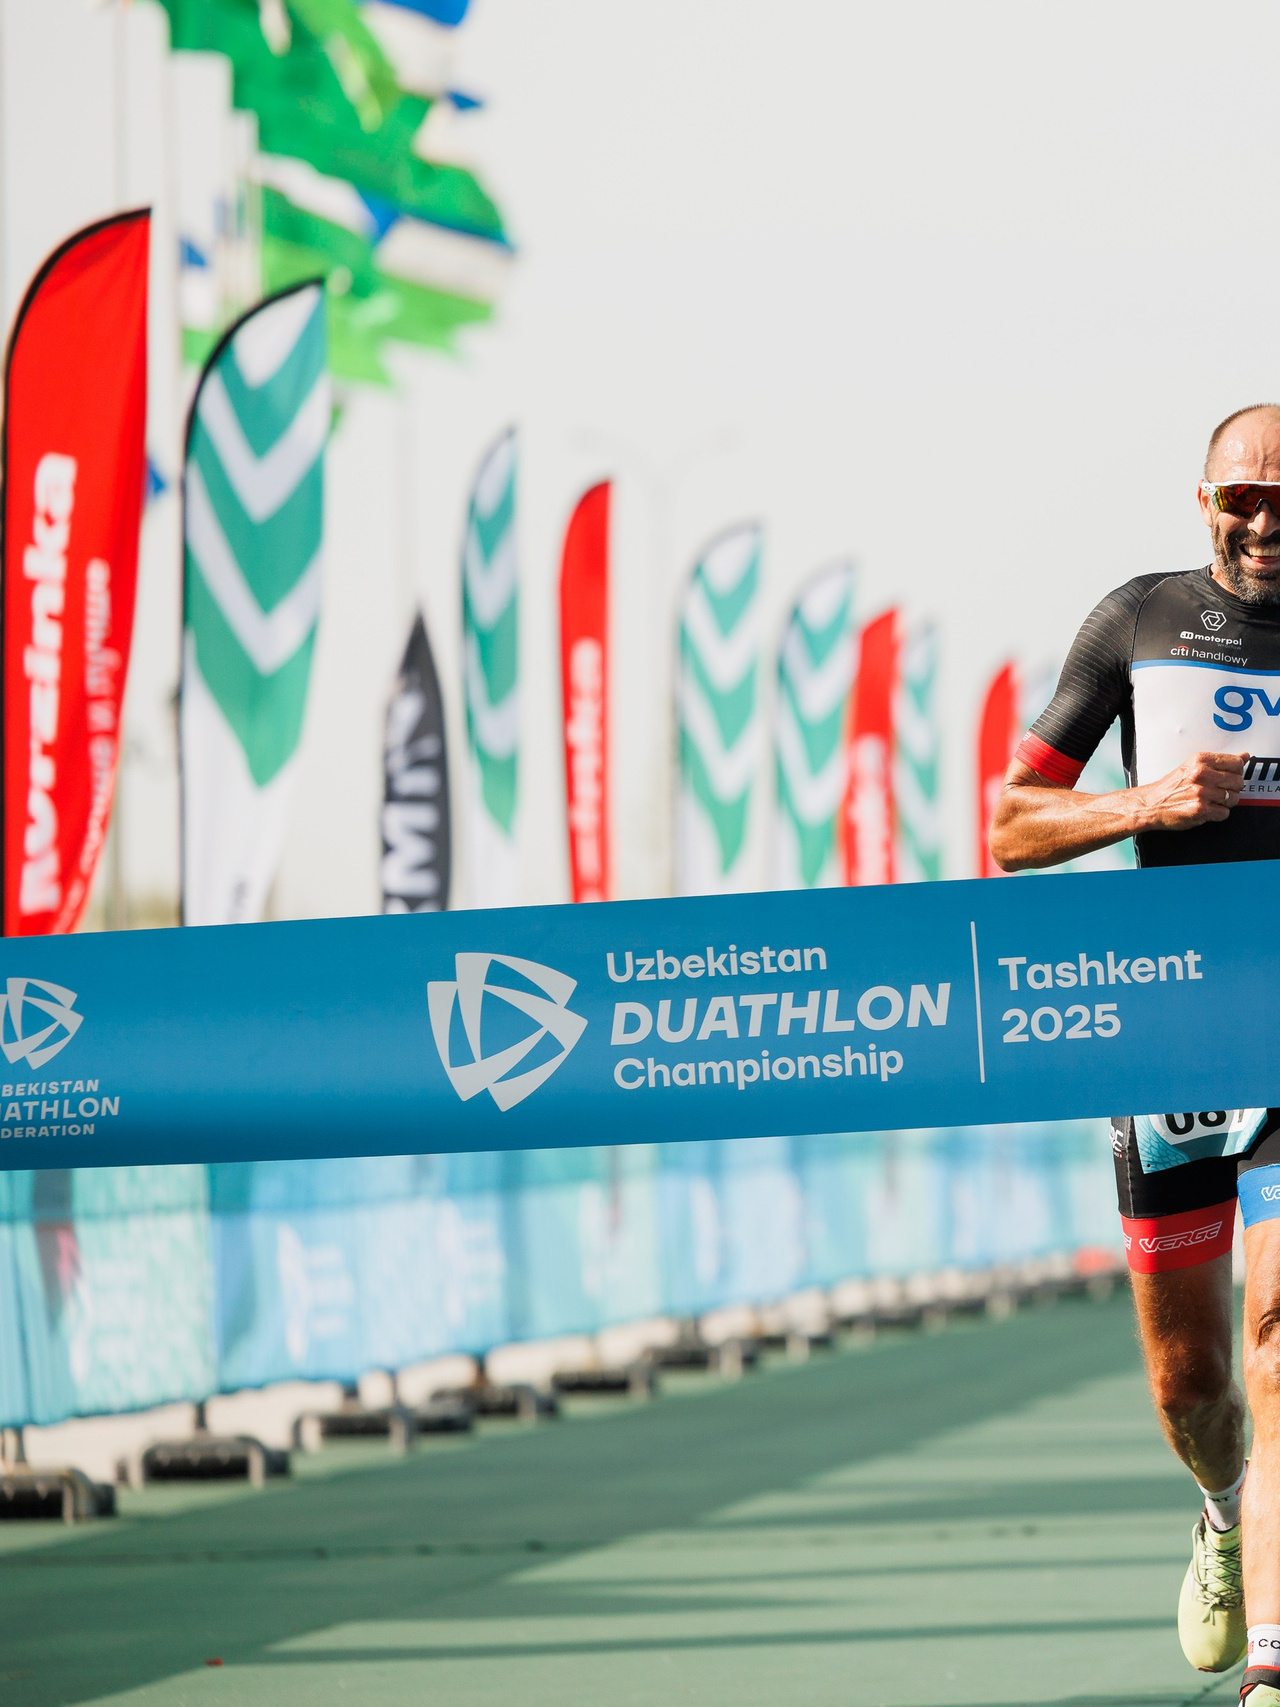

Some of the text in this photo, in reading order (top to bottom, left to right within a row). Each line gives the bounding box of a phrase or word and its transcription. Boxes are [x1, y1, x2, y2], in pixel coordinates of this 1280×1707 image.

[1170, 645, 1248, 666] citi handlowy
[1194, 634, 1242, 646] motorpol
[606, 944, 827, 983] Uzbekistan
[998, 950, 1203, 991] Tashkent
[610, 982, 951, 1046] DUATHLON
[1001, 1003, 1121, 1043] 2025
[613, 1043, 904, 1090] Championship
[0, 1079, 99, 1097] BEKISTAN
[0, 1096, 120, 1122] ATHLON
[0, 1123, 95, 1139] DERATION
[1139, 1221, 1223, 1253] VERGE
